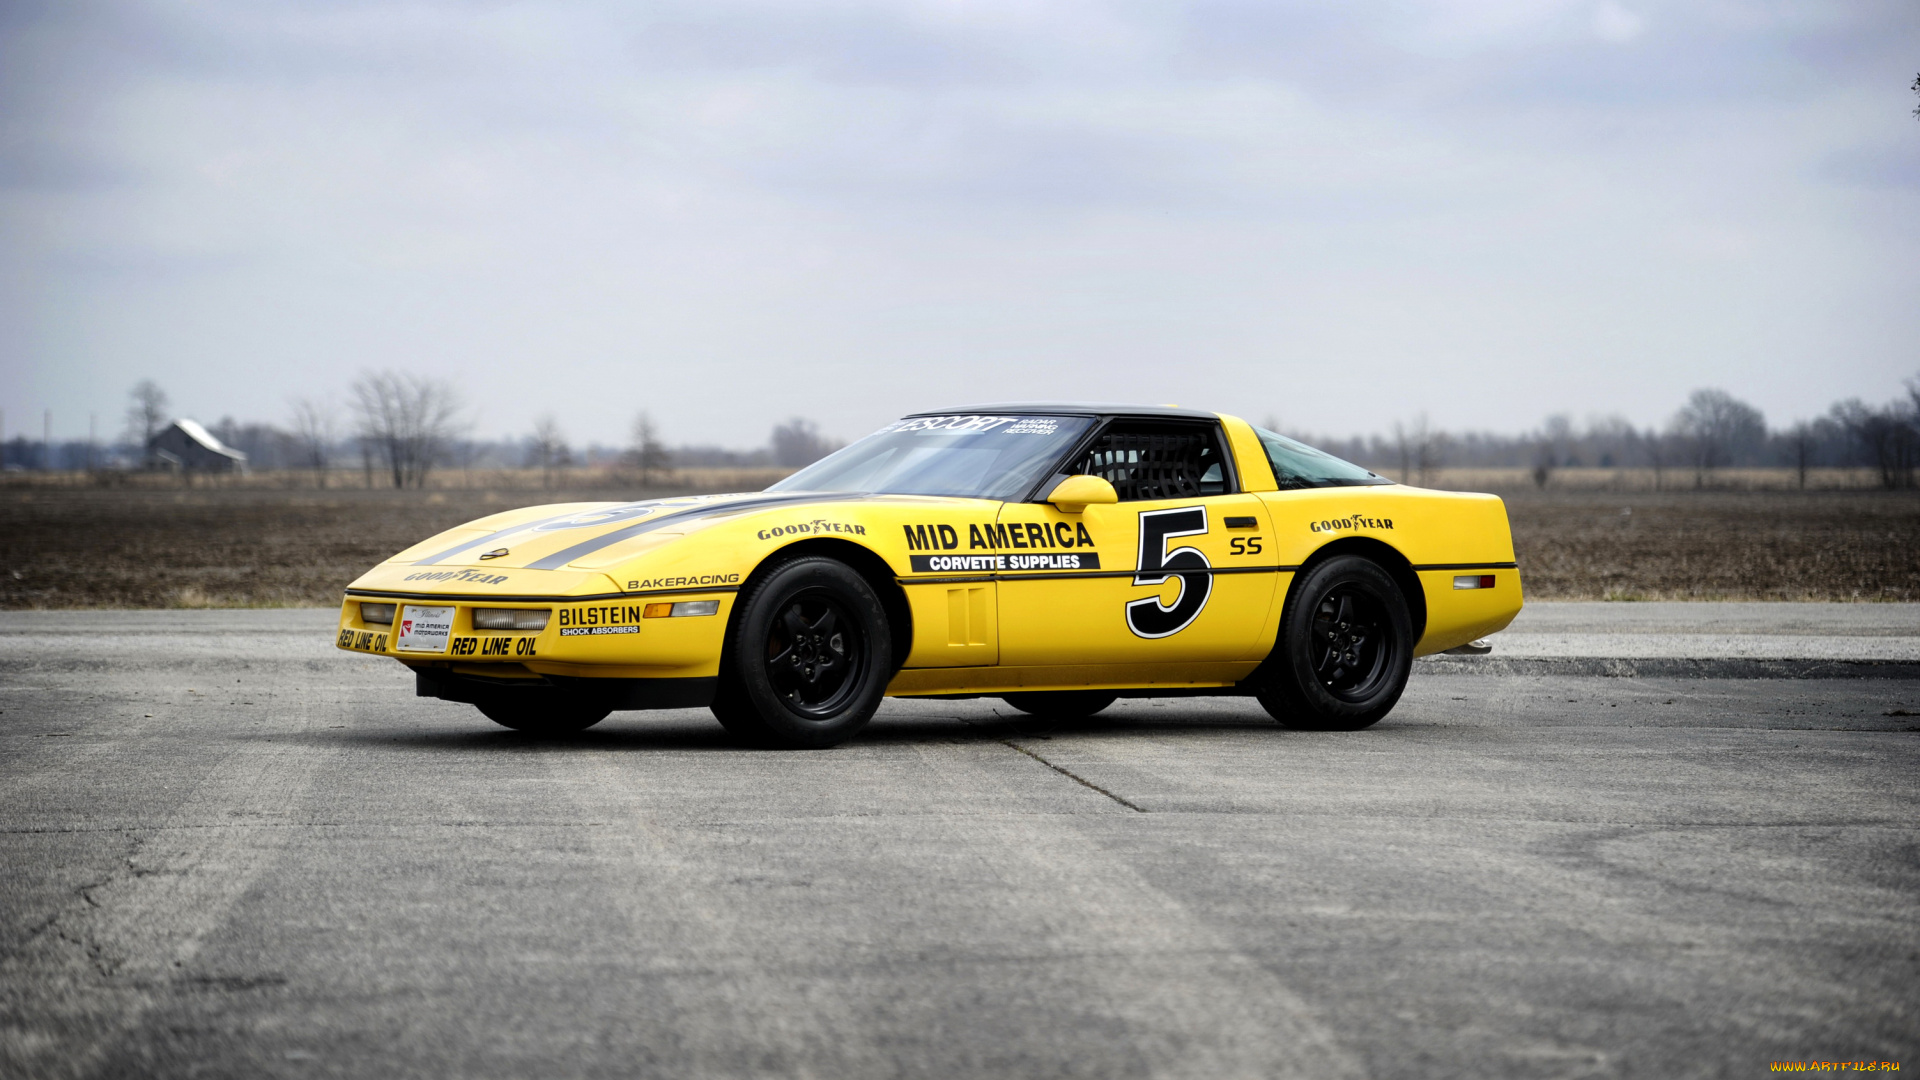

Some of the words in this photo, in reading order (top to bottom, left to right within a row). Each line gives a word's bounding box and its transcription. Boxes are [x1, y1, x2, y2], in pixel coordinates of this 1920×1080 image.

[893, 416, 1018, 432] ESCORT
[903, 524, 959, 551] MID
[969, 522, 1095, 549] AMERICA
[1230, 536, 1262, 555] SS
[929, 556, 1006, 571] CORVETTE
[1009, 554, 1081, 569] SUPPLIES
[1125, 505, 1214, 639] 5
[627, 573, 740, 590] BAKERACING
[559, 606, 641, 626] BILSTEIN
[338, 629, 353, 646] RED
[355, 632, 372, 649] LINE
[374, 634, 387, 652] OIL
[562, 628, 590, 636] SHOCK
[591, 626, 639, 635] ABSORBERS
[451, 637, 478, 655] RED
[481, 637, 512, 656] LINE
[516, 638, 537, 656] OIL
